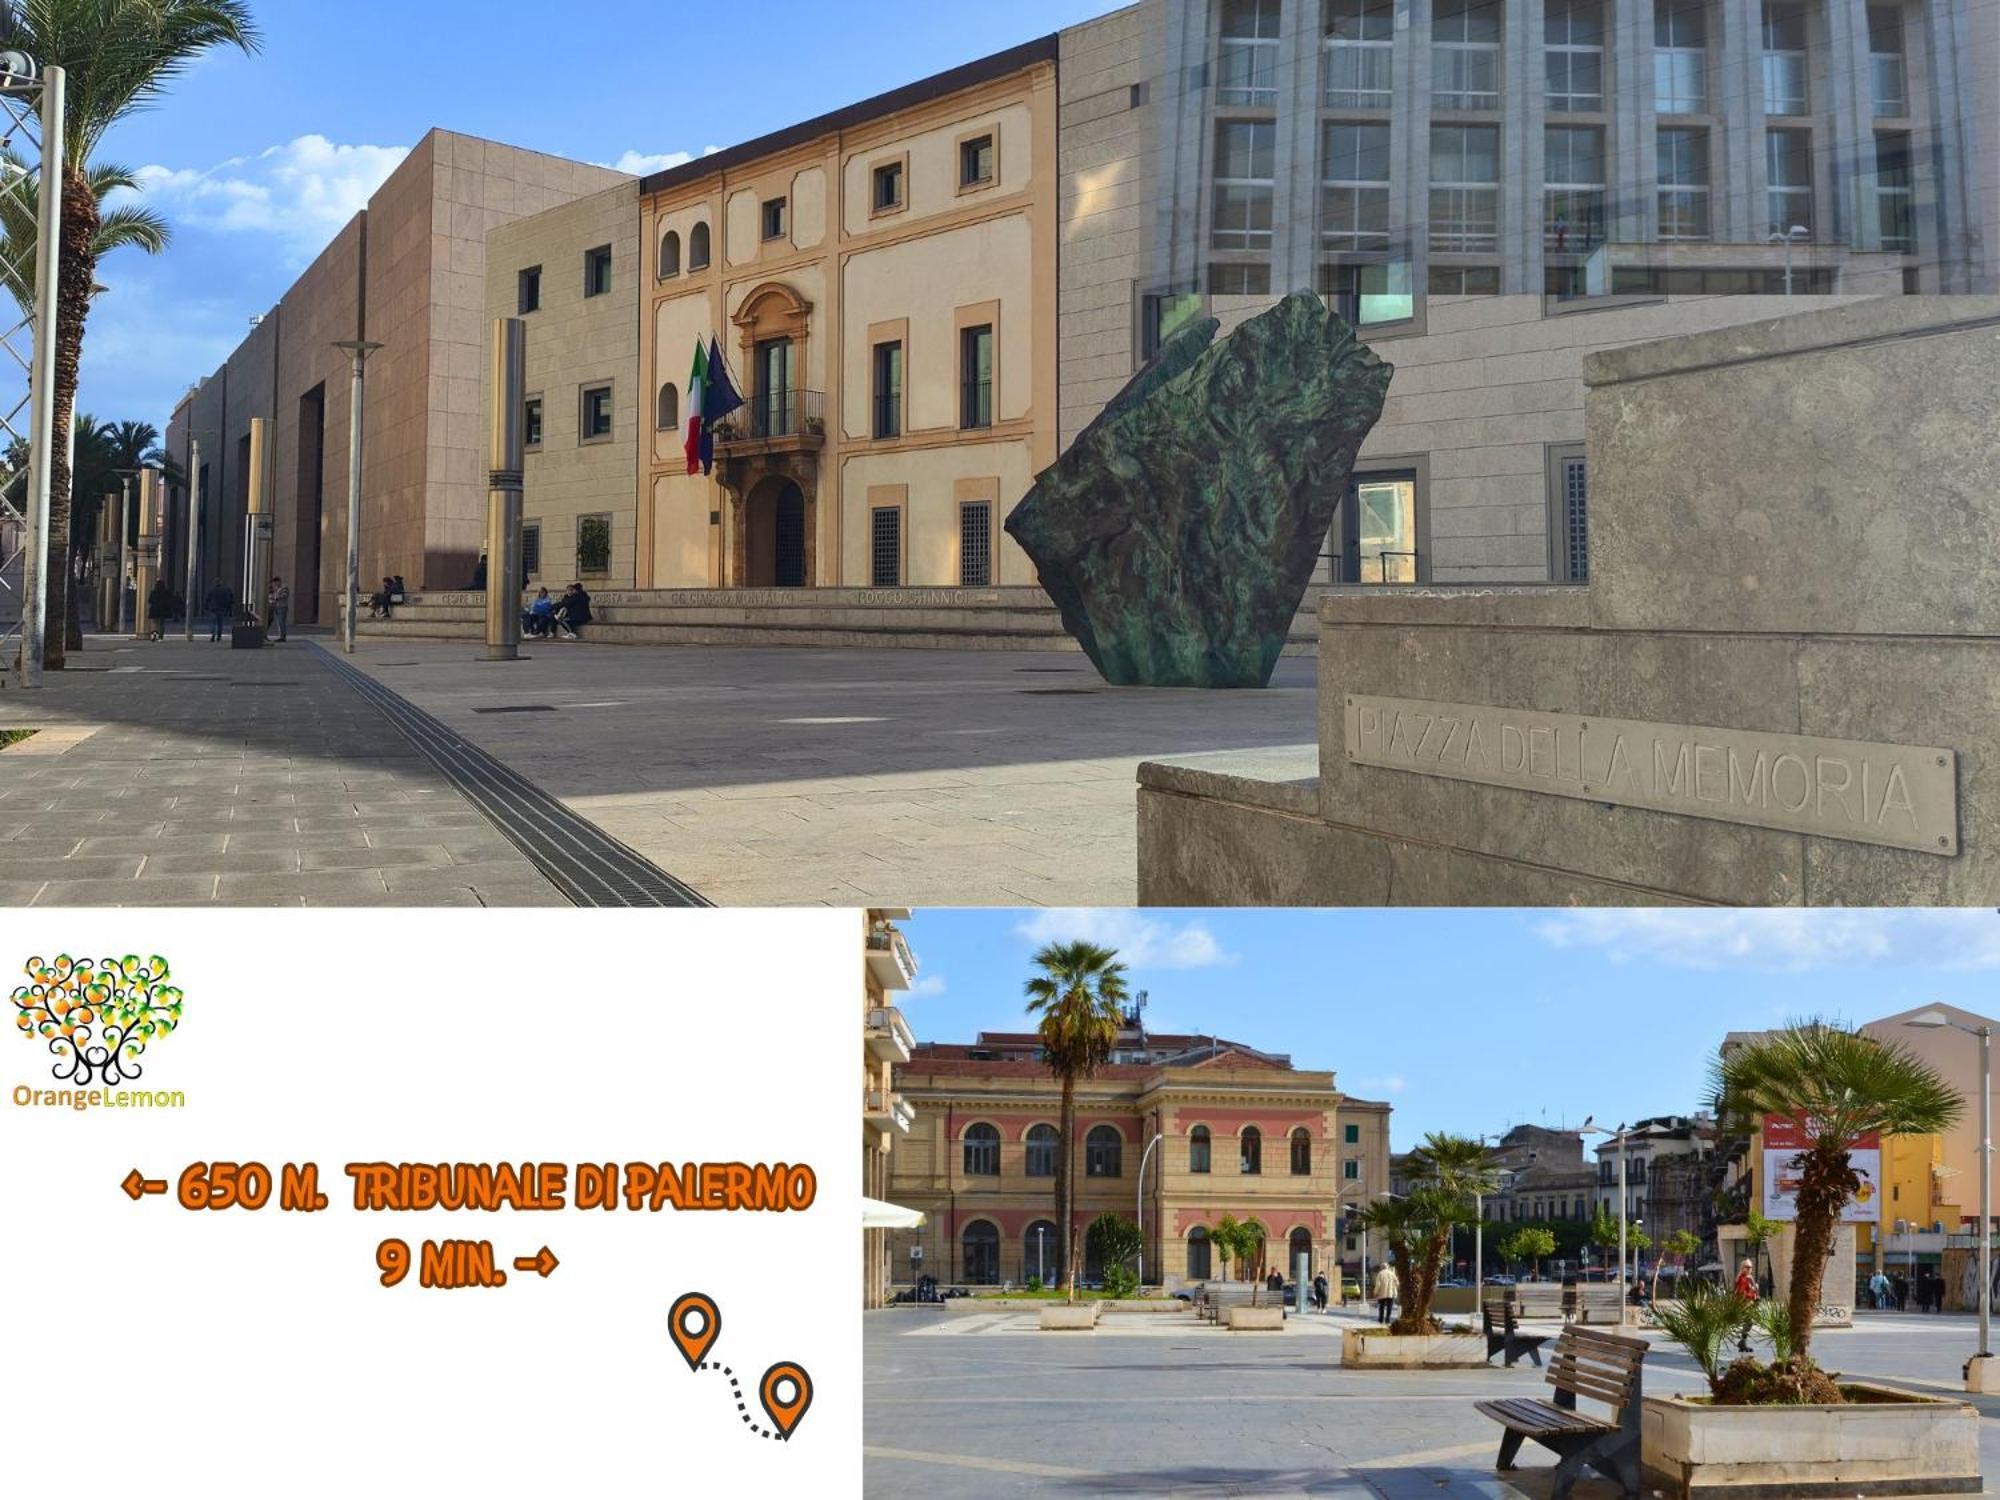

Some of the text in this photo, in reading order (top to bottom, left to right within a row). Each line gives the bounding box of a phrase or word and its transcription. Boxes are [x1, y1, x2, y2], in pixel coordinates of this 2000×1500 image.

[1357, 707, 1921, 831] PIAZZA DELLA MEMORIA
